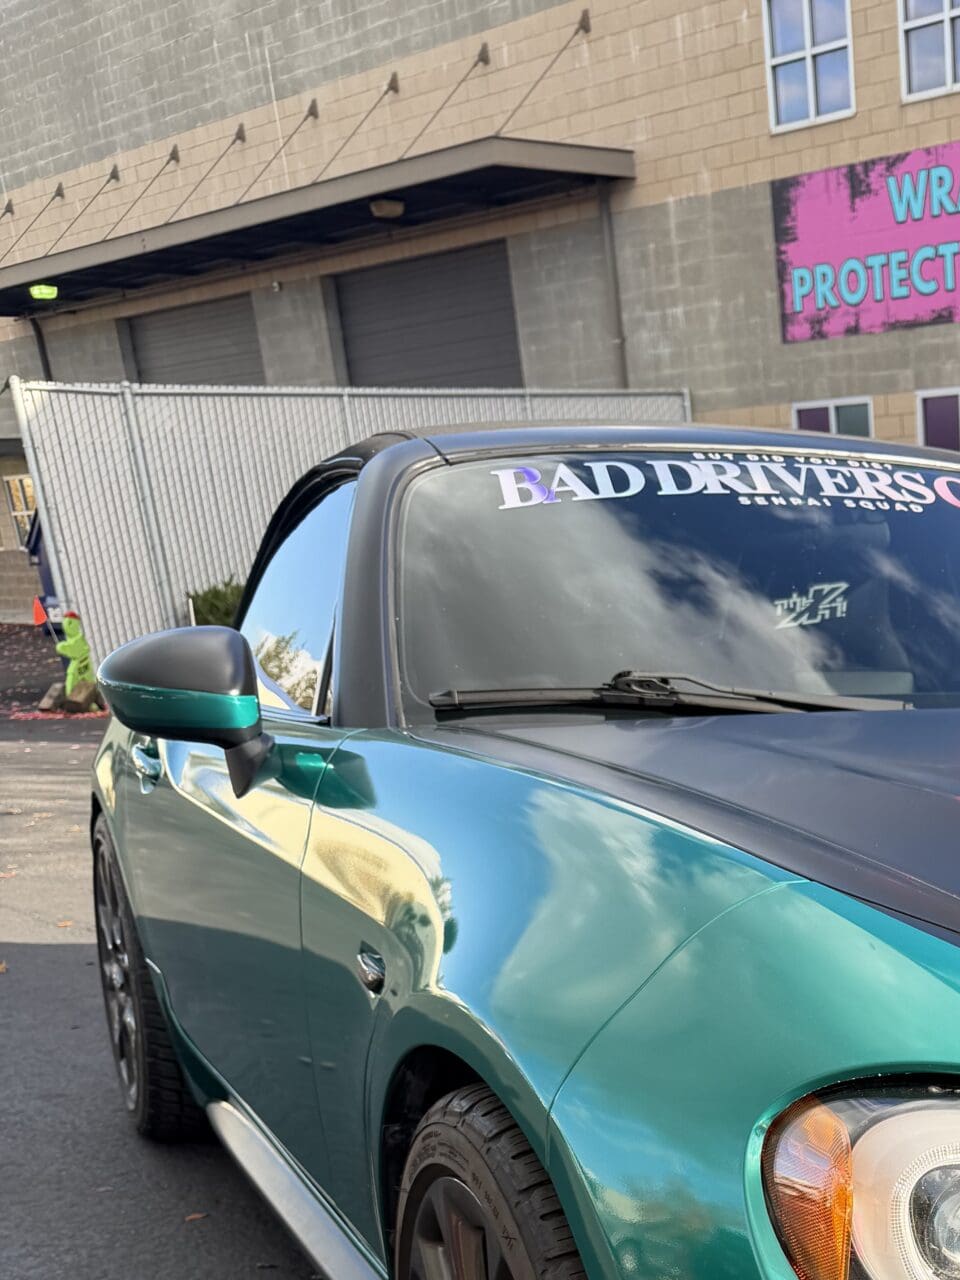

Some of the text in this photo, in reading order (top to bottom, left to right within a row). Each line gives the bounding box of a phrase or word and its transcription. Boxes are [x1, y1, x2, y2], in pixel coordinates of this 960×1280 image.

[791, 240, 960, 313] PROTECT
[692, 452, 734, 460] BUT
[746, 454, 785, 462] DID
[794, 456, 837, 465] YOU
[490, 461, 646, 509] BAD
[645, 460, 936, 505] DRIVERS
[738, 496, 923, 513] SENPAI SQUAD
